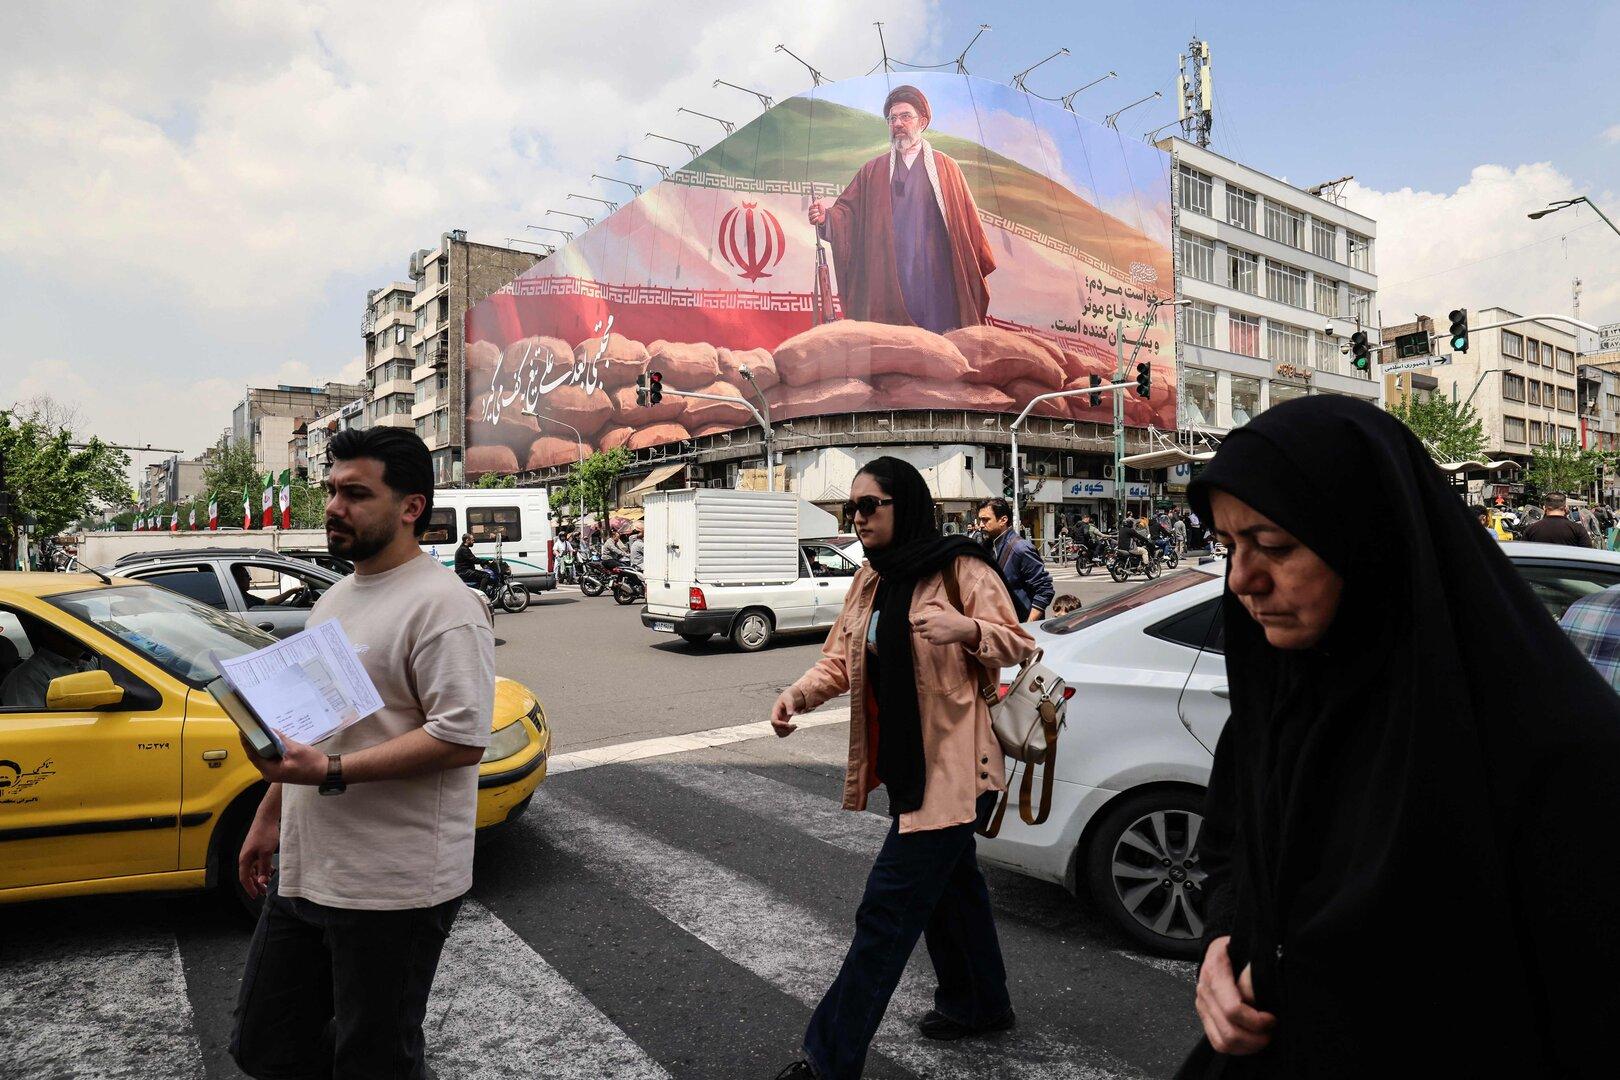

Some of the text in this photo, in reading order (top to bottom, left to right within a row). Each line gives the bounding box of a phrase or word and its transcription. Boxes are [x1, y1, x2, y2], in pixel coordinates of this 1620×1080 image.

[1124, 288, 1158, 308] خواست
[1106, 303, 1132, 322] دفاع
[1071, 481, 1104, 495] کوه نور
